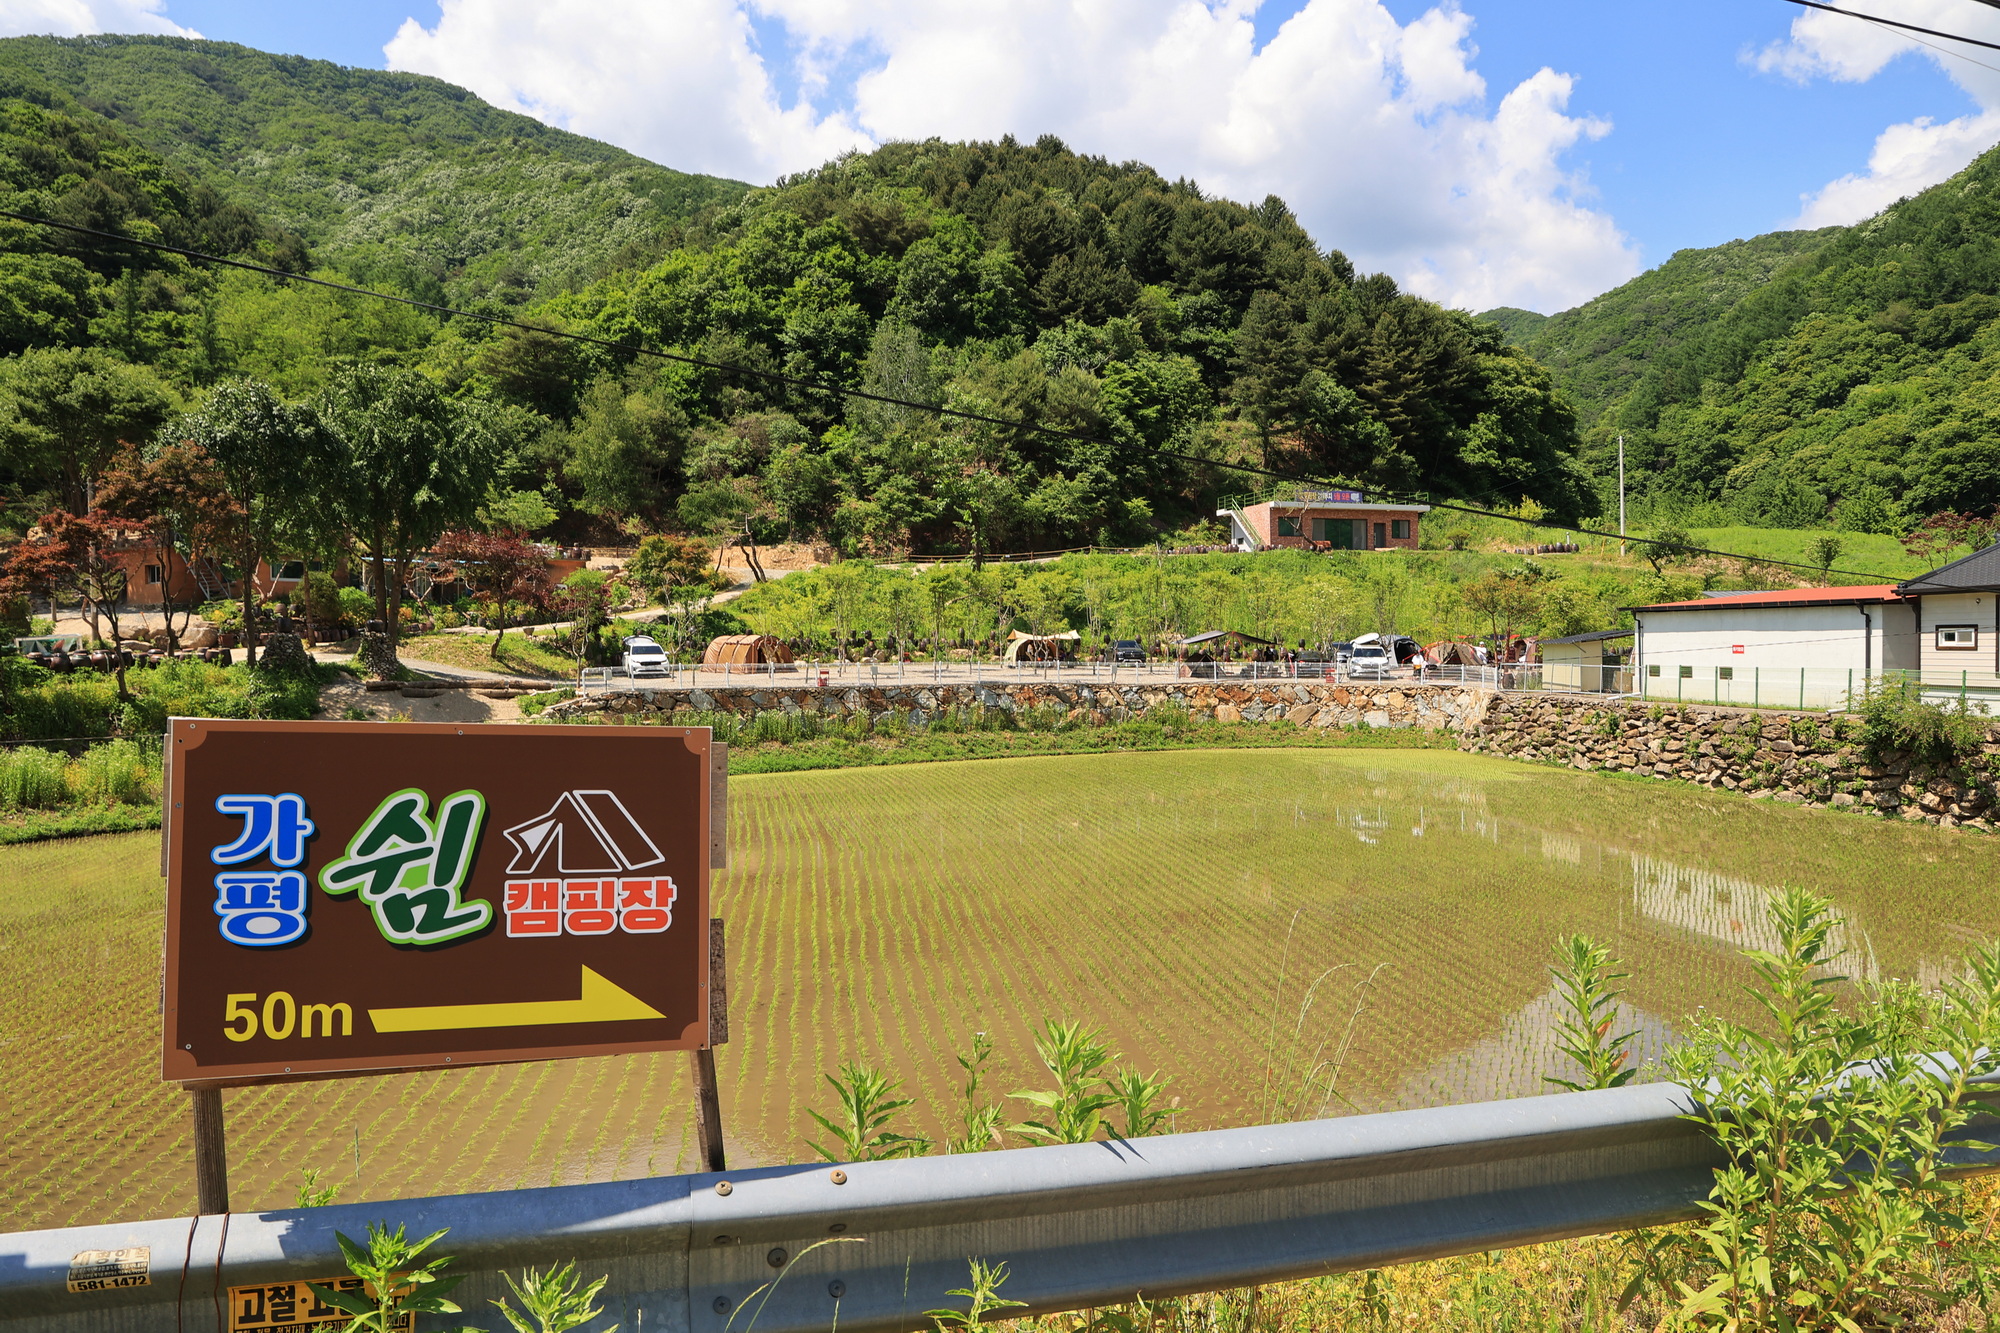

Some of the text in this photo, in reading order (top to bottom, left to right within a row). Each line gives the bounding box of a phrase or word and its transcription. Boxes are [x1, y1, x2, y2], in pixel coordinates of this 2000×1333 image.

[211, 788, 677, 946] 가평 쉼 캠핑장
[224, 991, 353, 1042] 50m
[77, 1275, 148, 1291] 581-1472
